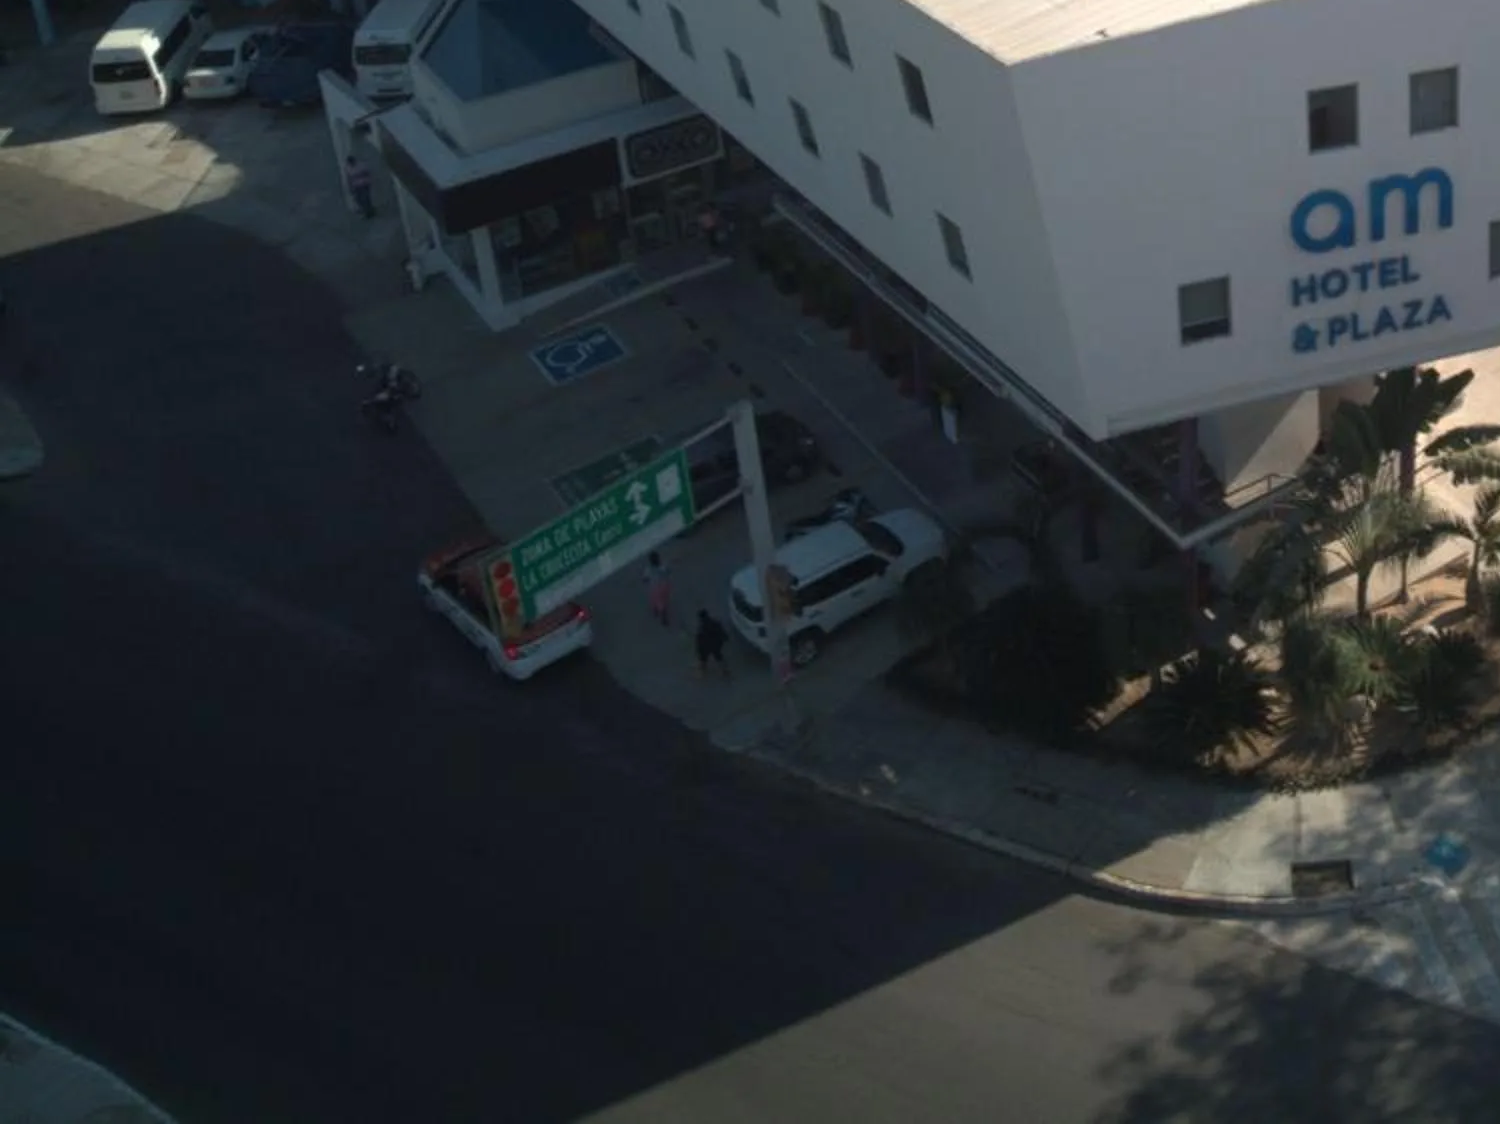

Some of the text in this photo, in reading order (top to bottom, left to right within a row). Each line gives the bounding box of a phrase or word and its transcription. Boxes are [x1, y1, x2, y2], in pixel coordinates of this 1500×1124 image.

[1290, 167, 1454, 253] am
[1290, 255, 1420, 307] HOTEL
[1292, 295, 1452, 354] & PLAZA
[553, 524, 572, 547] DE
[573, 497, 619, 533] PLAYAS
[522, 570, 540, 592] LA
